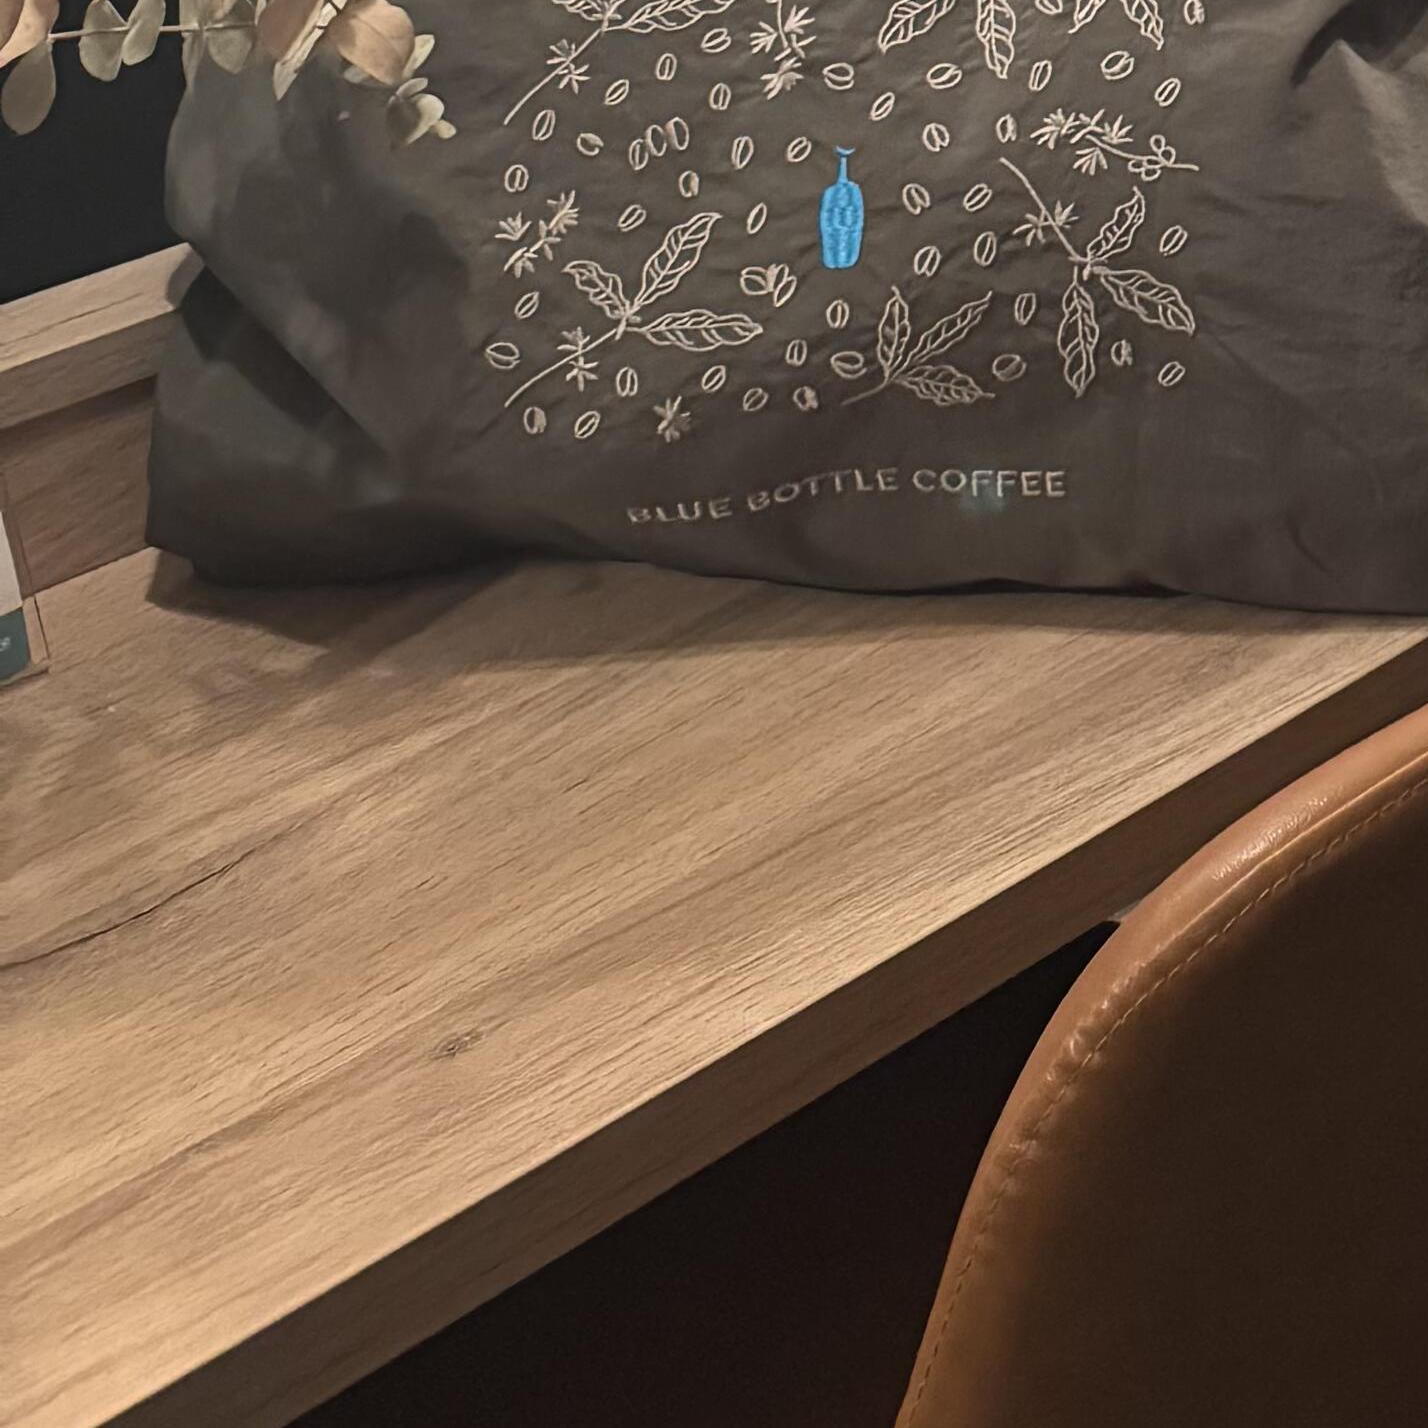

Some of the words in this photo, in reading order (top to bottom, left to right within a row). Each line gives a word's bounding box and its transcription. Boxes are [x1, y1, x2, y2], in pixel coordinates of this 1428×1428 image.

[627, 497, 733, 524] BLUE
[747, 467, 899, 512] BOTTLE
[911, 467, 1068, 499] COFFEE
